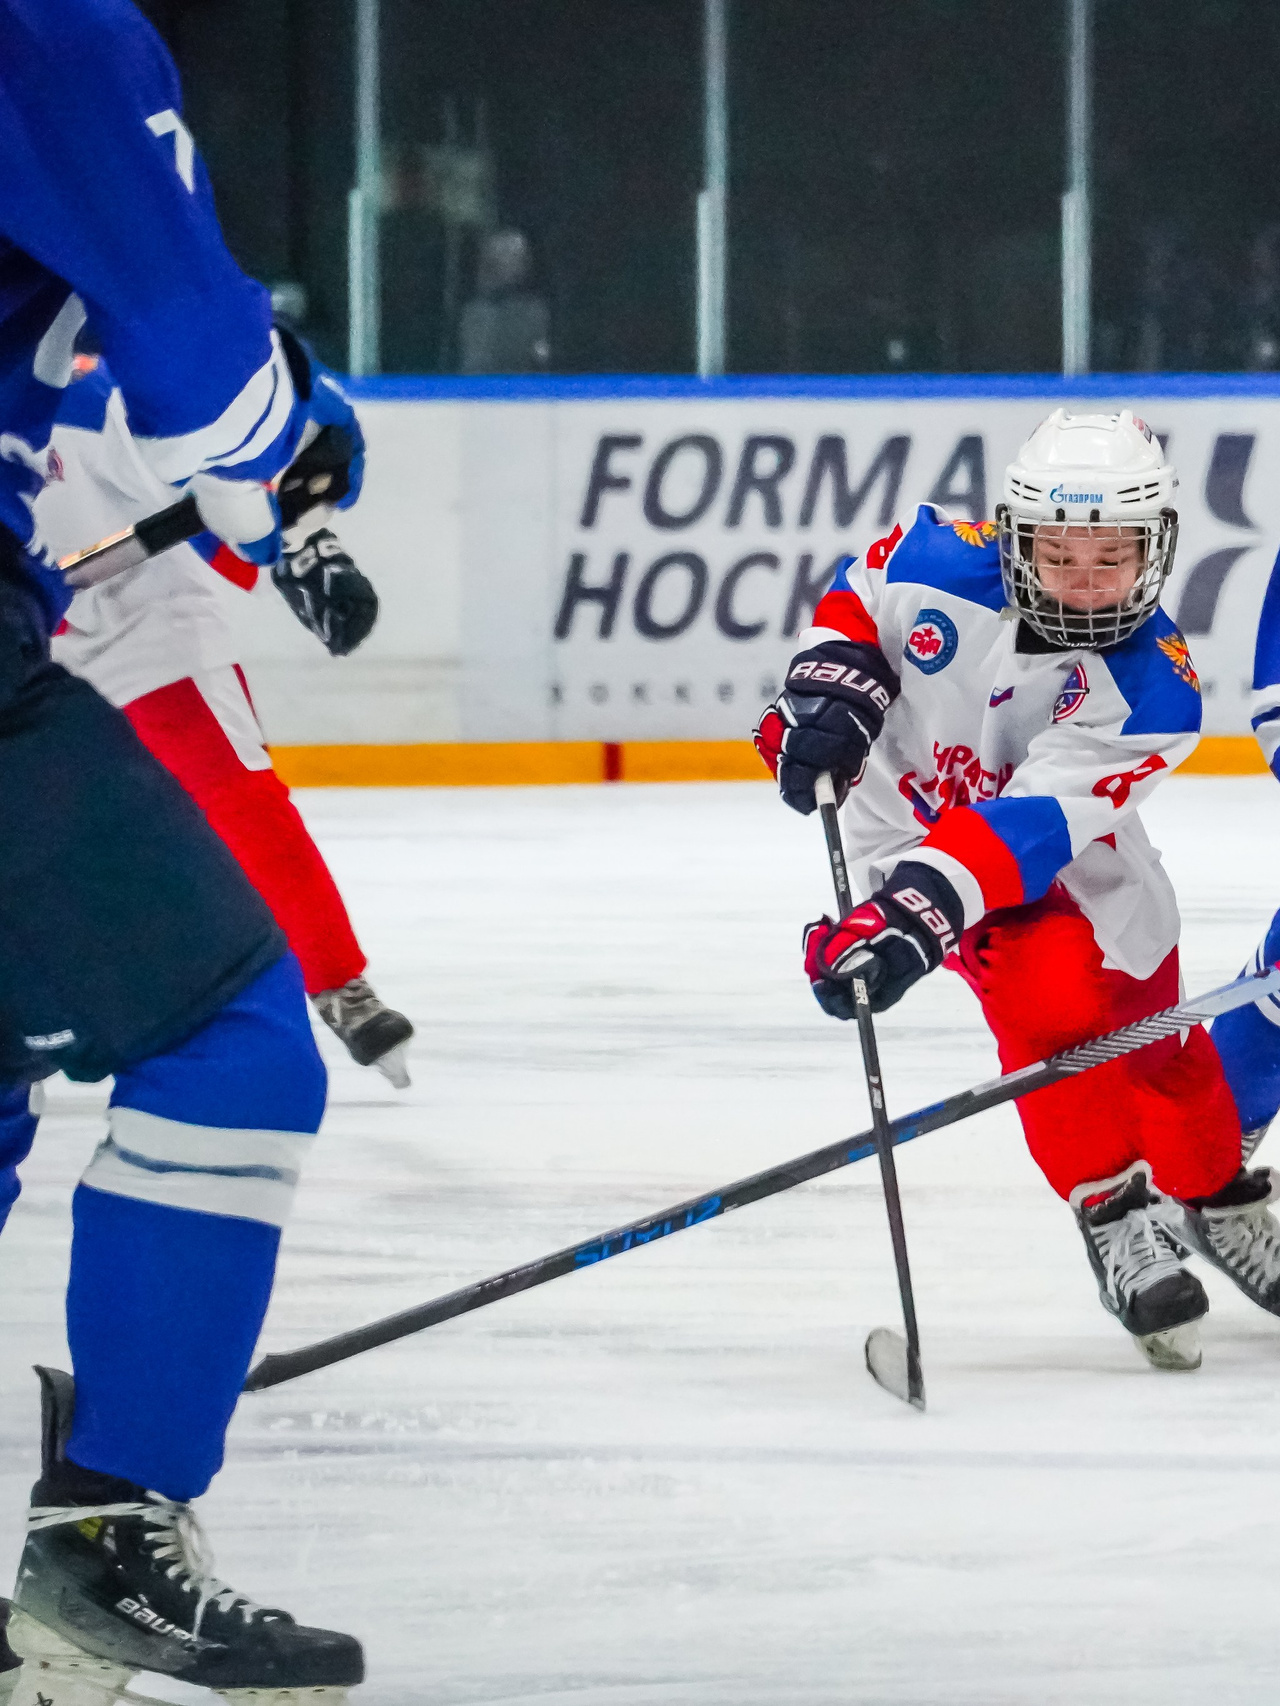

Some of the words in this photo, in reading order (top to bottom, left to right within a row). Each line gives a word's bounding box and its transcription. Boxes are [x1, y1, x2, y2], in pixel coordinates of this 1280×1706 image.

[578, 433, 988, 531] FORMA
[1064, 493, 1104, 504] ГАЗПРОМ
[553, 550, 858, 641] HOCK
[790, 660, 891, 711] BAUE
[892, 886, 960, 957] BAU
[115, 1594, 194, 1641] BAUE
